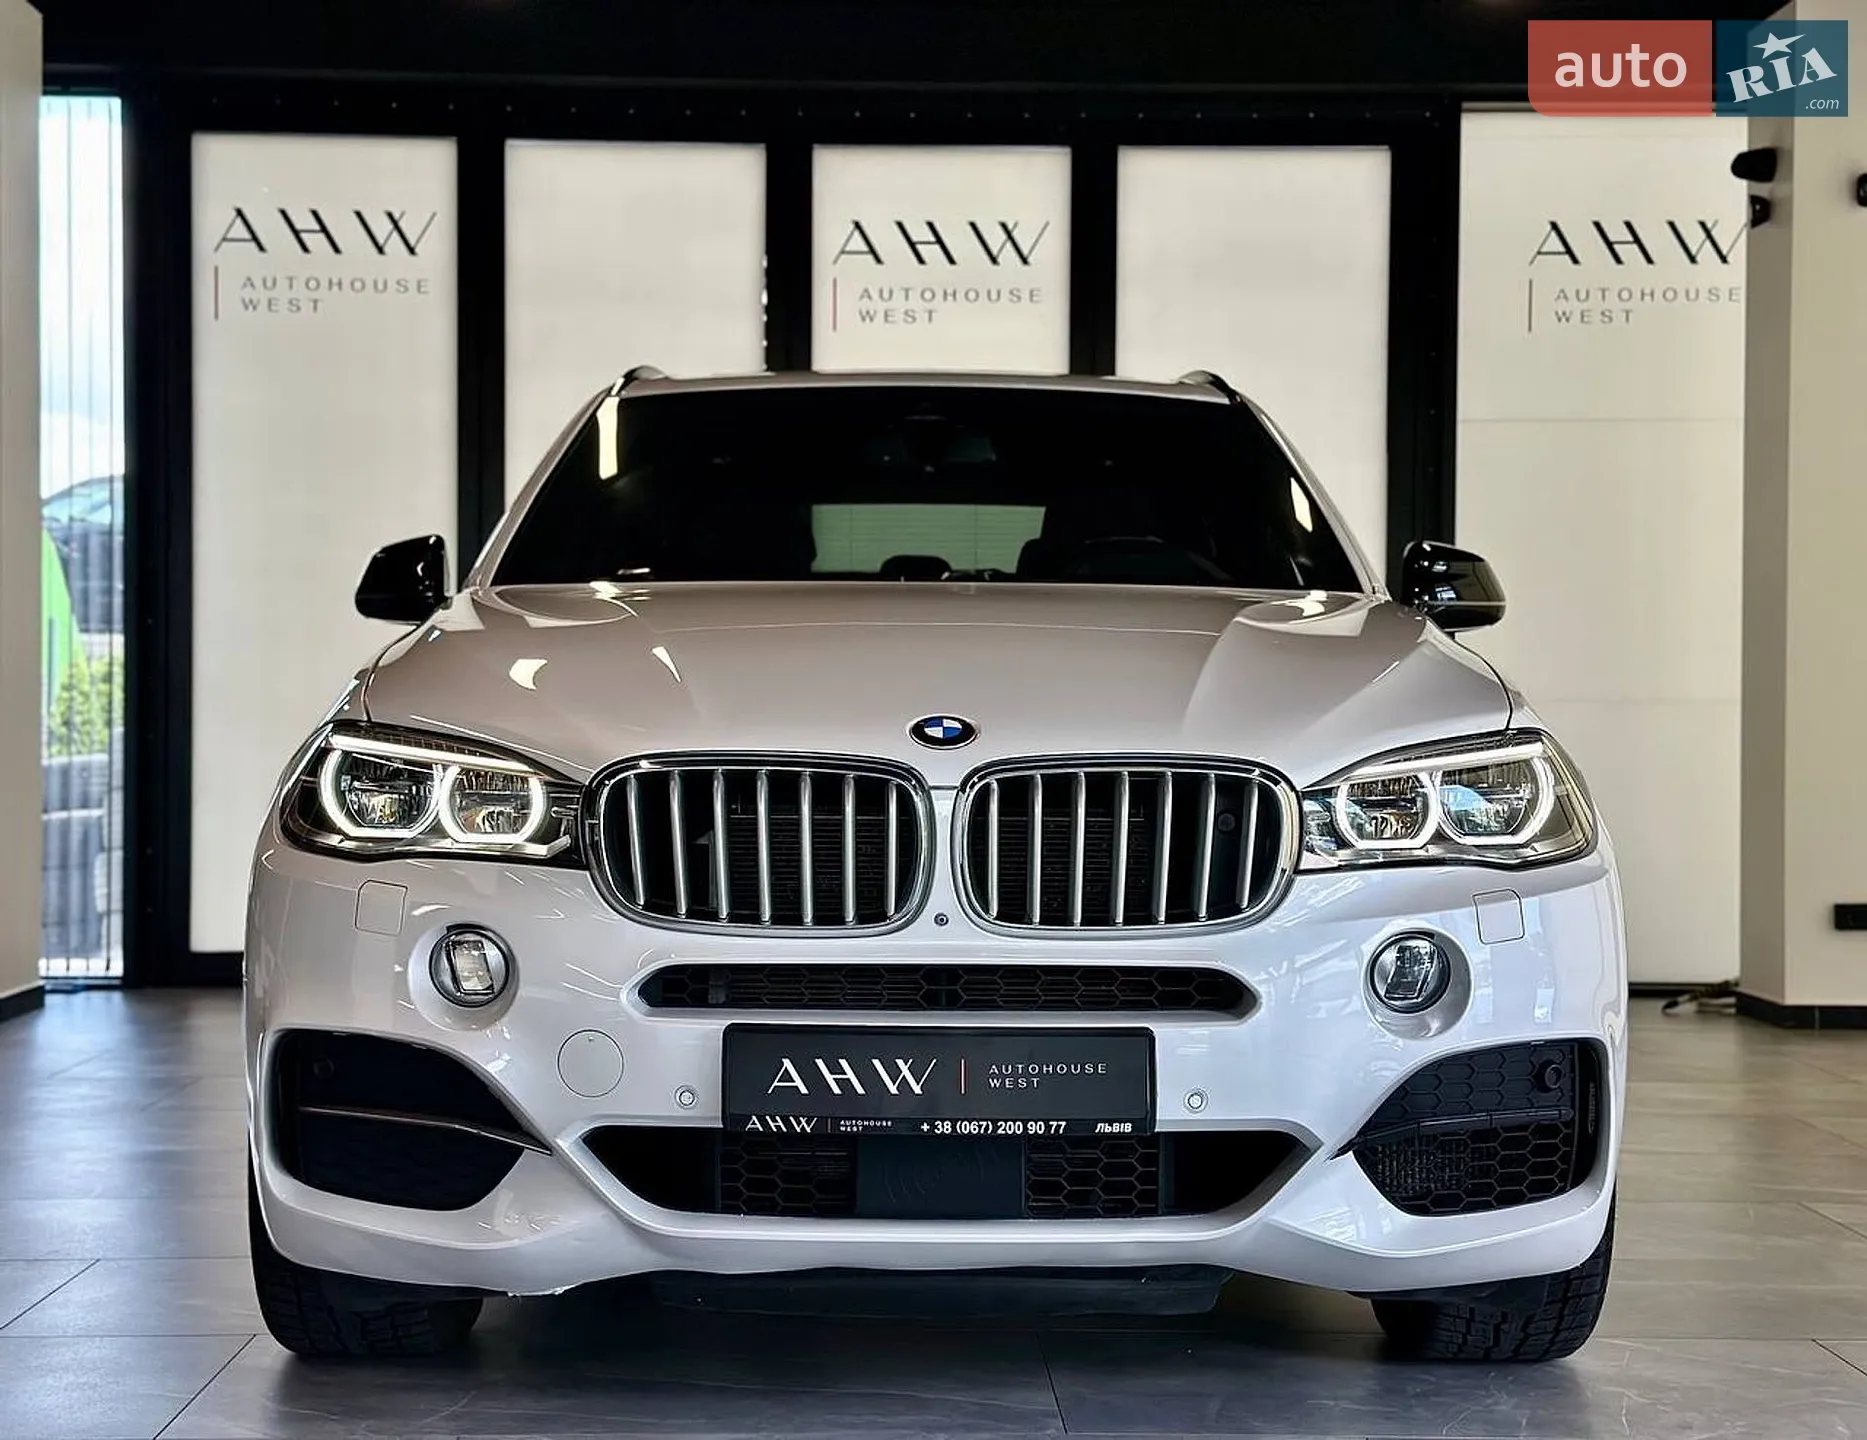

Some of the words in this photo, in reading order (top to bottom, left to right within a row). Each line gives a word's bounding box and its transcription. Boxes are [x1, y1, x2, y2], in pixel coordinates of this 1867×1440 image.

[214, 207, 437, 256] AHW
[833, 220, 1049, 265] AHW
[1529, 220, 1747, 265] AHW
[241, 276, 430, 294] AUTOHOUSE
[858, 288, 1042, 303] AUTOHOUSE
[1554, 287, 1742, 303] AUTOHOUSE
[241, 298, 321, 313] WEST
[858, 309, 936, 324] WEST
[1554, 309, 1633, 324] WEST
[767, 1058, 937, 1095] AHW
[989, 1064, 1107, 1074] AUTOHOUSE
[988, 1078, 1040, 1088] WEST
[745, 1115, 818, 1133] AHW
[934, 1121, 951, 1134] 38
[956, 1120, 992, 1135] (067)
[997, 1121, 1023, 1134] 200
[1027, 1121, 1045, 1134] 90
[1049, 1121, 1066, 1134] 77
